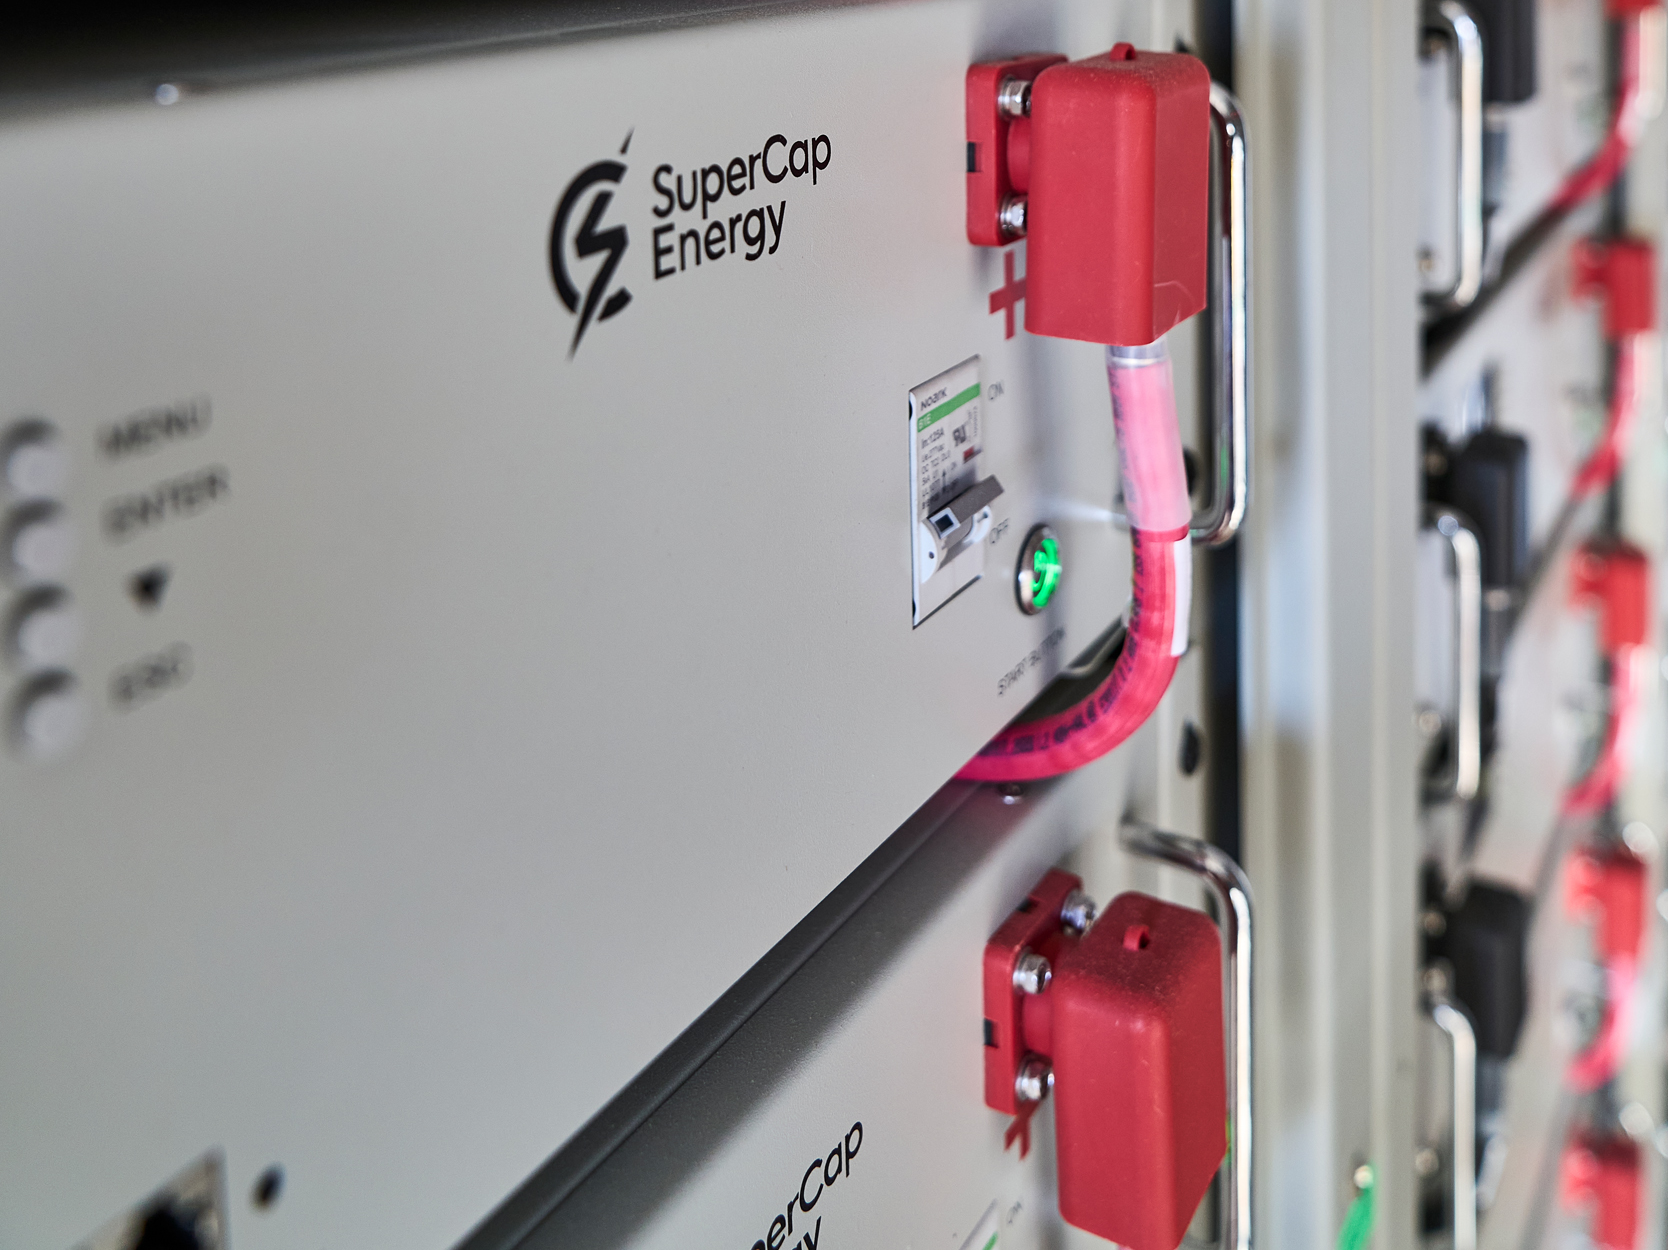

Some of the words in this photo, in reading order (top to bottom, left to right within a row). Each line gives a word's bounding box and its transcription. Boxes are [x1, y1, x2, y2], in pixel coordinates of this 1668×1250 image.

[652, 134, 831, 220] SuperCap
[653, 200, 786, 280] Energy
[988, 381, 1005, 401] ON
[990, 518, 1009, 544] OFF
